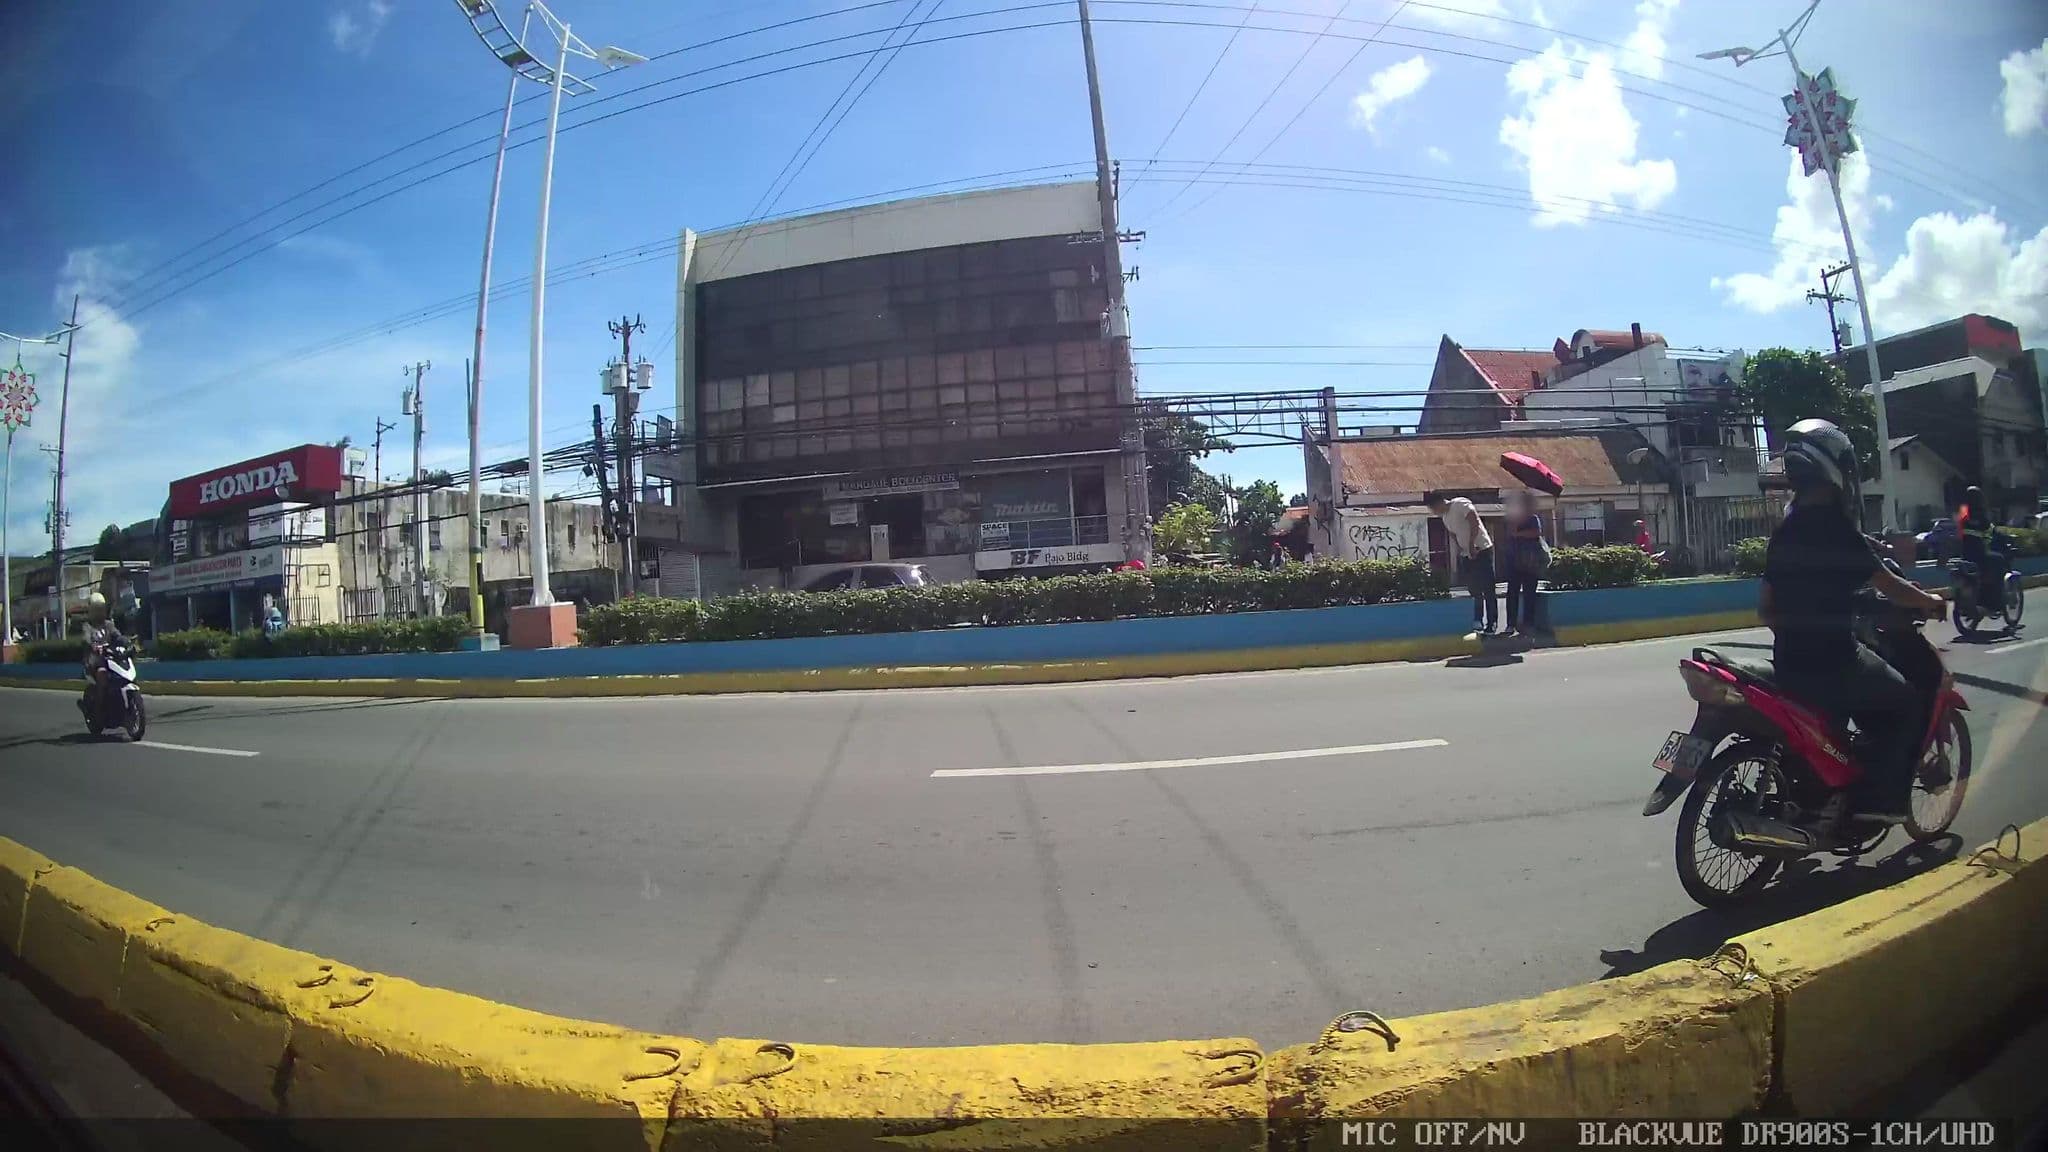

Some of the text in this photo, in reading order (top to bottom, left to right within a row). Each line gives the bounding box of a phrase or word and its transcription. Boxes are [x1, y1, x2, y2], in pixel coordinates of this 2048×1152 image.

[200, 460, 299, 504] HONDA
[1011, 550, 1042, 566] BF
[1067, 552, 1089, 562] Bldg
